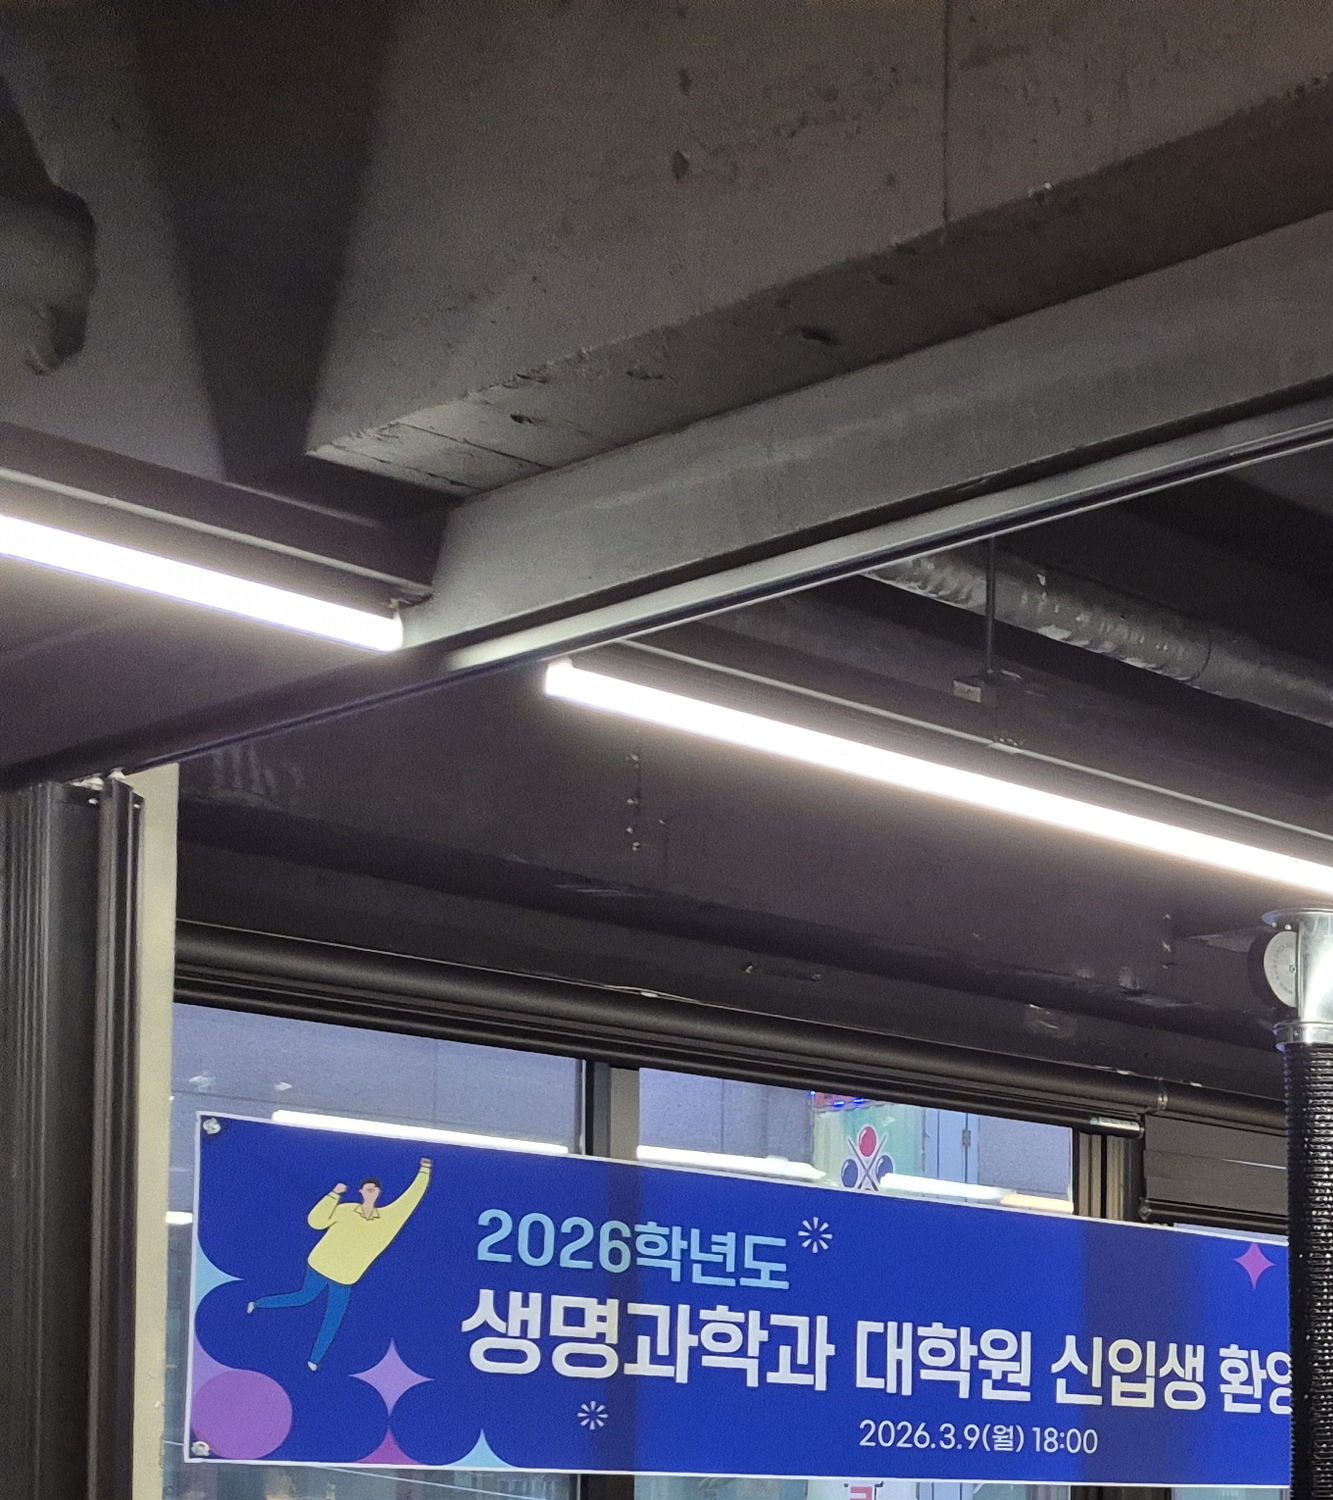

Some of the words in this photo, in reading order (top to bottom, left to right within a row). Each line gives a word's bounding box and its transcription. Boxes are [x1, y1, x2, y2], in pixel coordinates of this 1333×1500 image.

[477, 1208, 790, 1290] 2026학년도
[461, 1286, 836, 1392] 생명과학과
[855, 1320, 1032, 1402] 대학원
[1050, 1334, 1207, 1411] 신입생
[859, 1419, 1024, 1453] 2026.3.9(월)
[1032, 1426, 1098, 1454] 18:00
